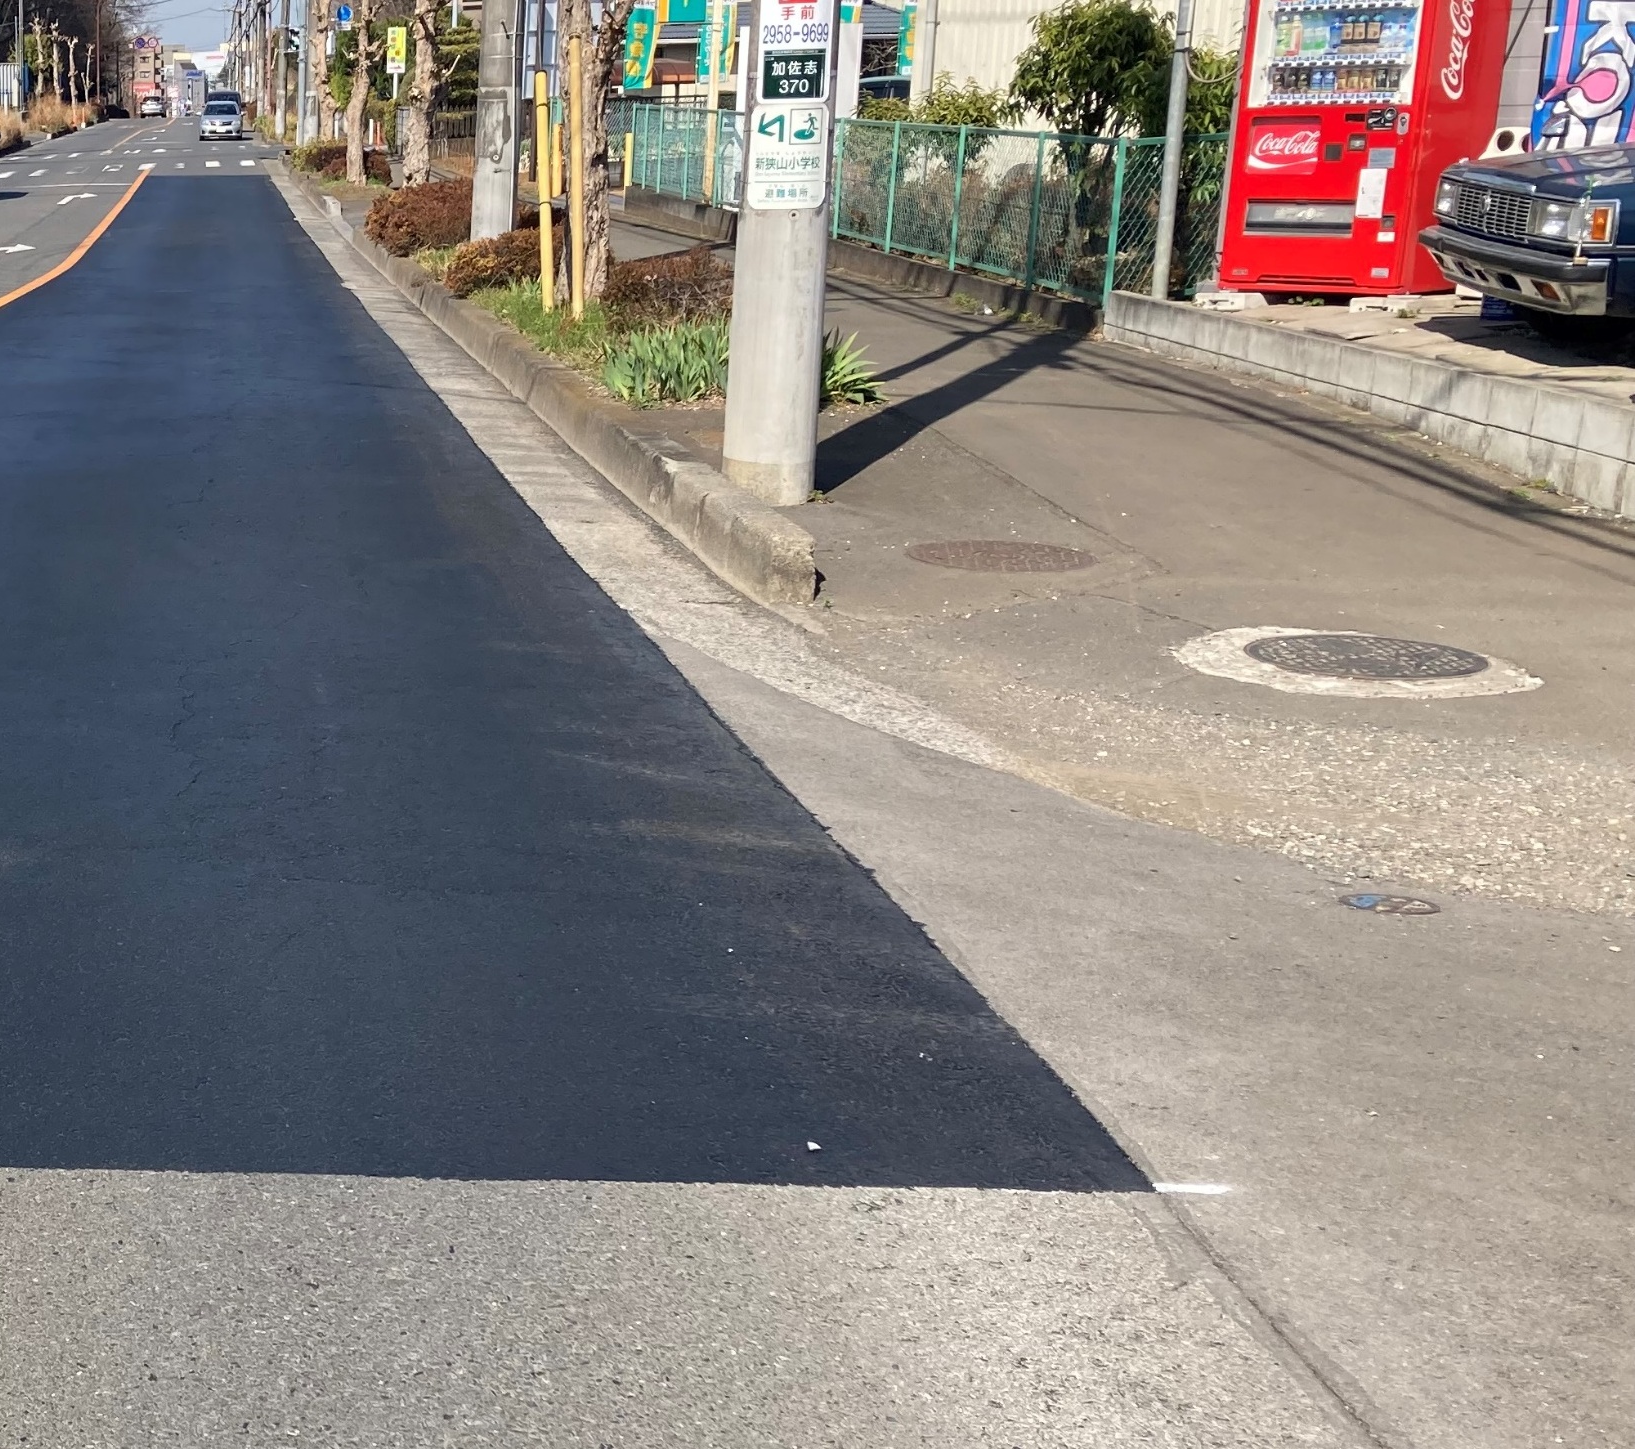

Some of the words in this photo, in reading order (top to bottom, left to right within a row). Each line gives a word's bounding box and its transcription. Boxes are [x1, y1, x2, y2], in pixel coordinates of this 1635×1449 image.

[781, 5, 815, 20] 手前
[763, 23, 829, 44] 2958-9699
[1441, 0, 1475, 100] Coca-Co
[772, 60, 818, 76] 加佐志
[778, 78, 810, 94] 370
[1255, 131, 1321, 156] Coca-Cola
[755, 156, 821, 170] 新狭山小学校
